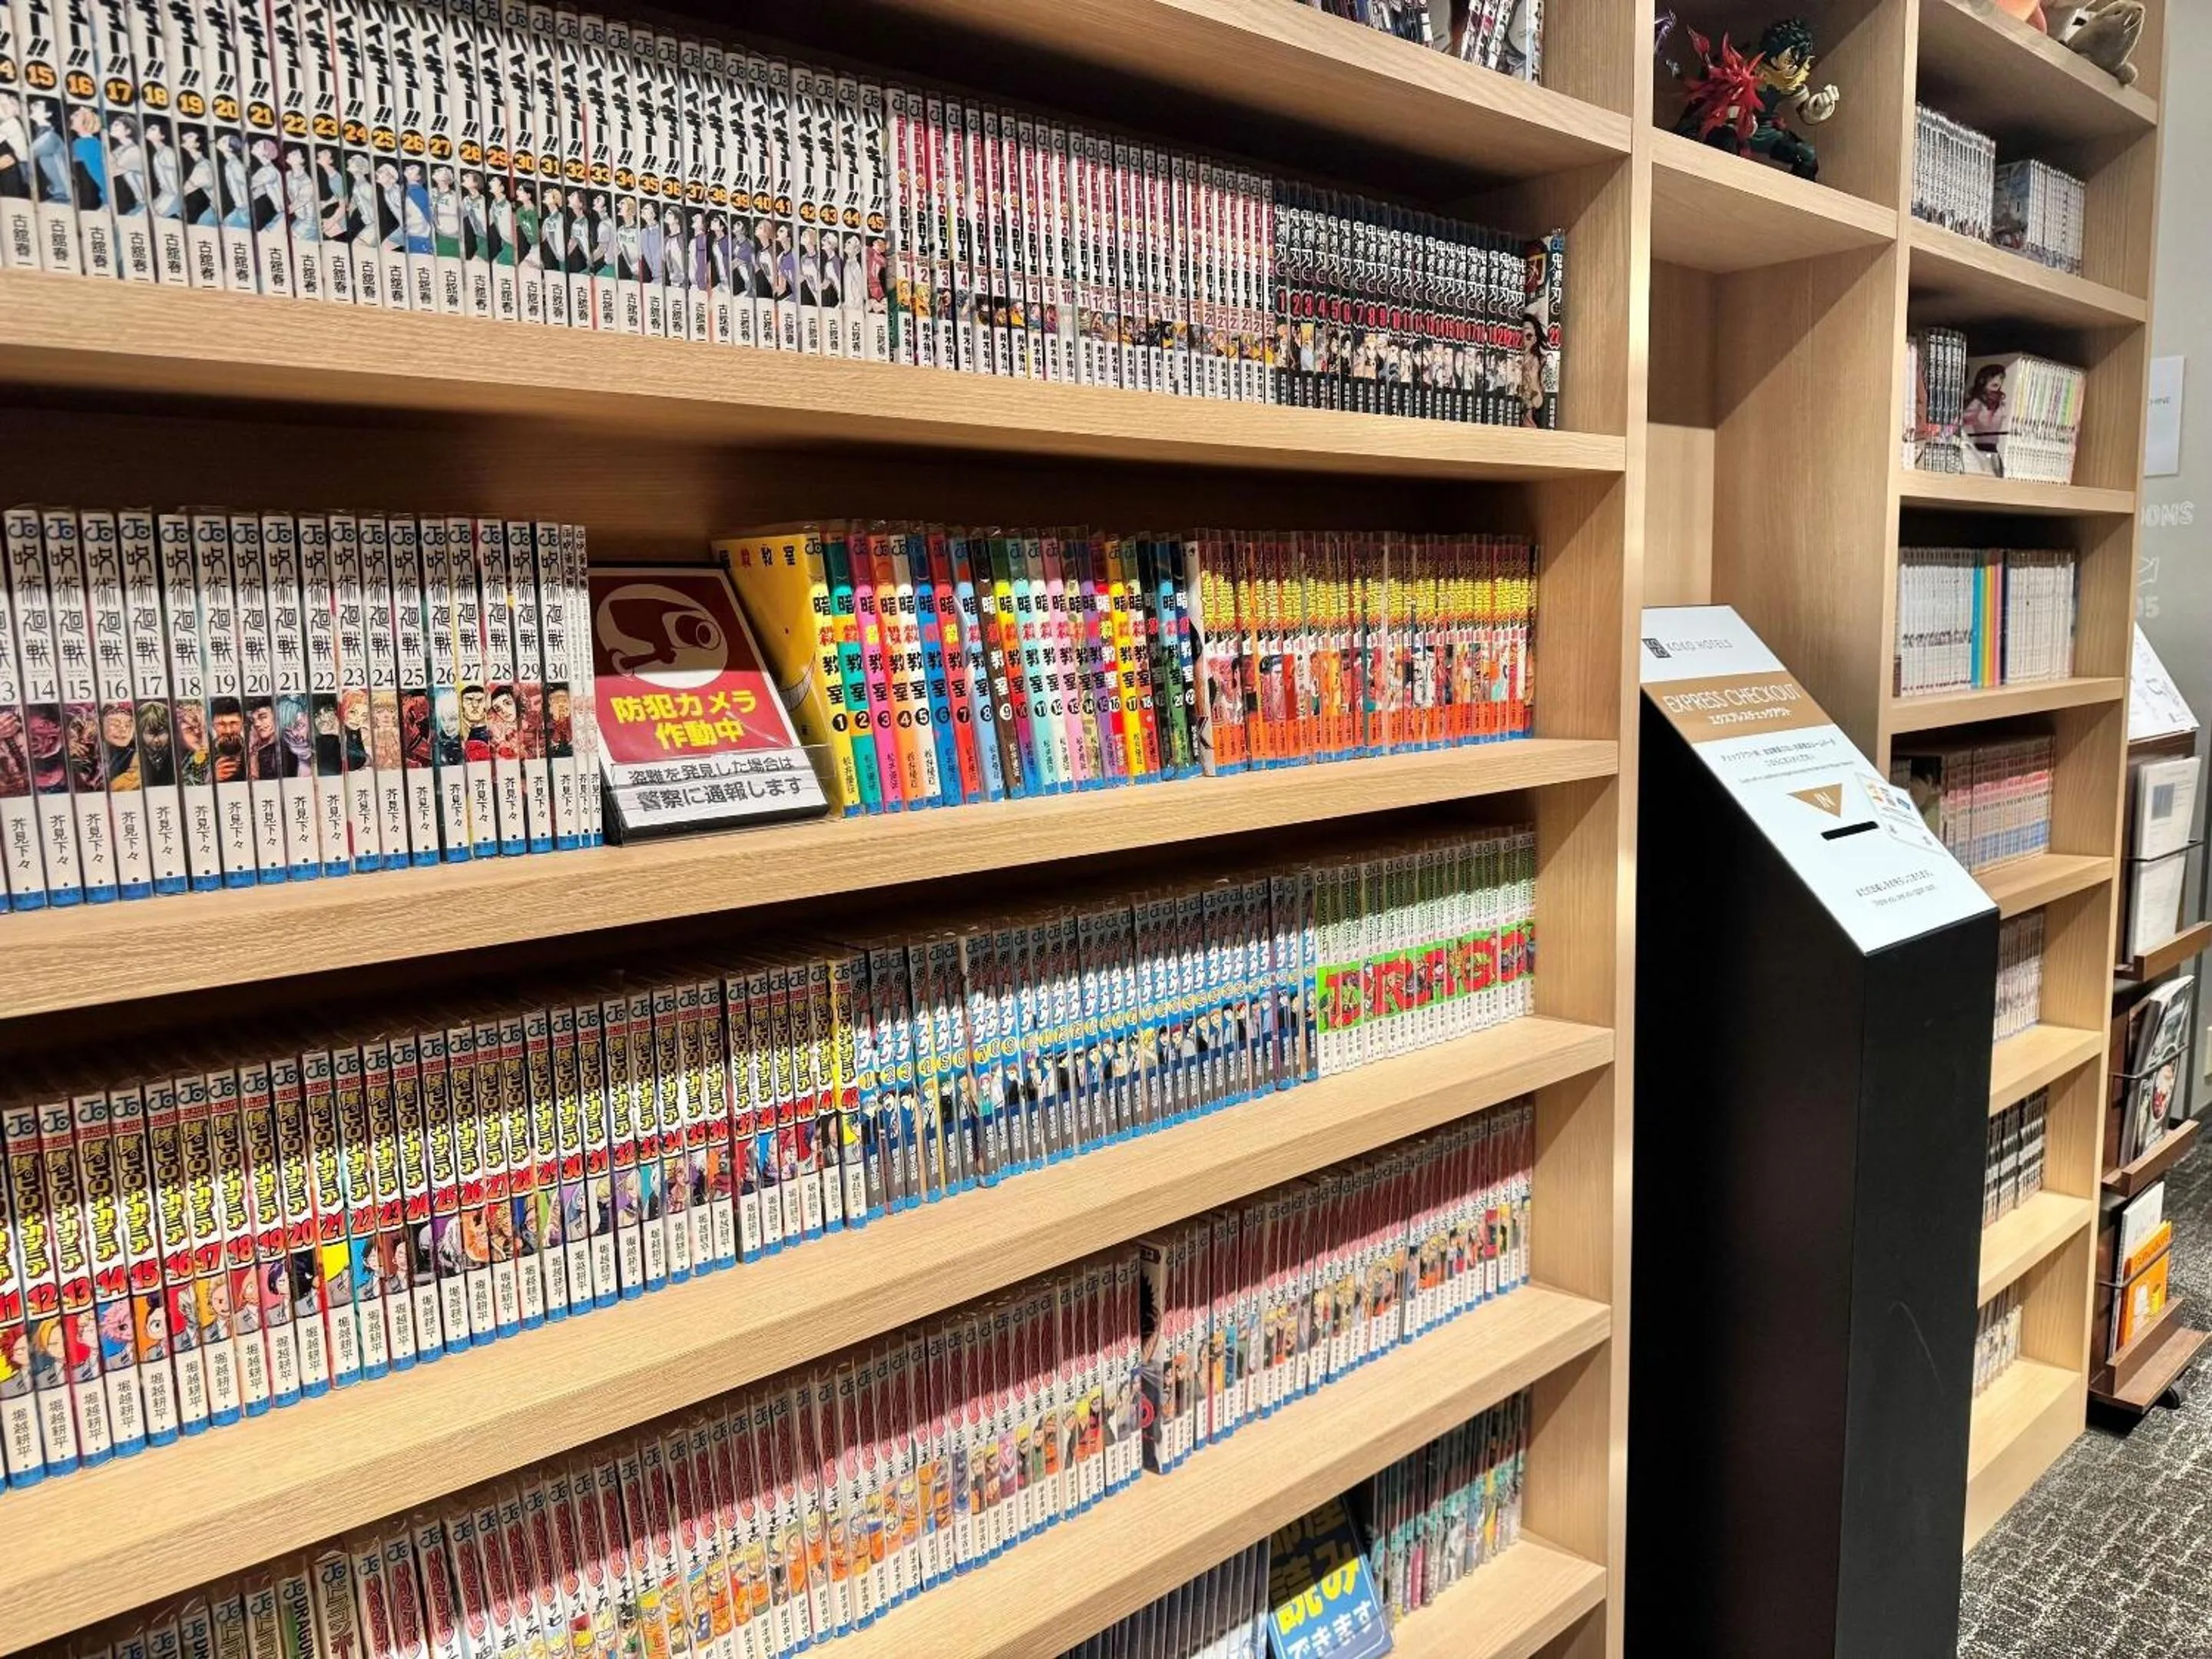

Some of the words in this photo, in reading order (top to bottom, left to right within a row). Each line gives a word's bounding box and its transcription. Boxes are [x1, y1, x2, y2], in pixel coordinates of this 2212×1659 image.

[27, 63, 55, 87] 15
[67, 74, 94, 97] 16
[143, 85, 168, 108] 18
[249, 105, 274, 127] 21
[313, 118, 339, 137] 23
[372, 131, 396, 150] 25
[429, 137, 452, 157] 27
[461, 143, 482, 162] 28
[514, 154, 535, 172] 30
[540, 158, 561, 176] 31
[590, 167, 611, 184] 33
[774, 198, 792, 216] 41
[800, 204, 816, 220] 42
[843, 210, 861, 227] 44
[867, 214, 884, 231] 45
[902, 263, 910, 279] 1
[920, 268, 929, 283] 2
[941, 270, 950, 287] 3
[960, 273, 969, 290] 4
[979, 276, 988, 293] 5
[1015, 281, 1022, 296] 7
[1048, 286, 1056, 303] 9
[279, 671, 301, 691] 21
[313, 671, 335, 690] 22
[343, 667, 365, 687] 23
[373, 668, 395, 687] 24
[403, 667, 424, 687] 25
[435, 667, 456, 685] 26
[462, 663, 481, 681] 27
[492, 663, 512, 680] 28
[521, 663, 541, 680] 29
[548, 662, 568, 680] 30
[31, 679, 55, 700] 14
[68, 679, 91, 700] 15
[105, 677, 128, 699] 16
[141, 676, 163, 696] 17
[179, 676, 201, 697] 18
[214, 674, 235, 694] 19
[247, 674, 269, 693] 20
[611, 690, 757, 724] 防犯カメラ
[1662, 690, 1727, 714] EXPRESS
[1724, 684, 1801, 706] CHECKOUT
[654, 717, 744, 750] 作動中
[628, 756, 792, 785] 盗難を発見した場合は
[636, 777, 803, 812] 警察に通報します
[1814, 792, 1836, 808] IN
[588, 1148, 608, 1174] 31
[435, 1185, 459, 1213] 25
[462, 1181, 485, 1207] 26
[406, 1194, 429, 1220] 24
[322, 1210, 345, 1240] 21
[352, 1205, 376, 1233] 22
[259, 1227, 286, 1257] 19
[289, 1219, 315, 1248] 20
[166, 1250, 192, 1280] 16
[195, 1241, 221, 1273] 17
[96, 1267, 126, 1297] 14
[131, 1259, 159, 1289] 15
[28, 1283, 58, 1315] 12
[61, 1277, 91, 1309] 13
